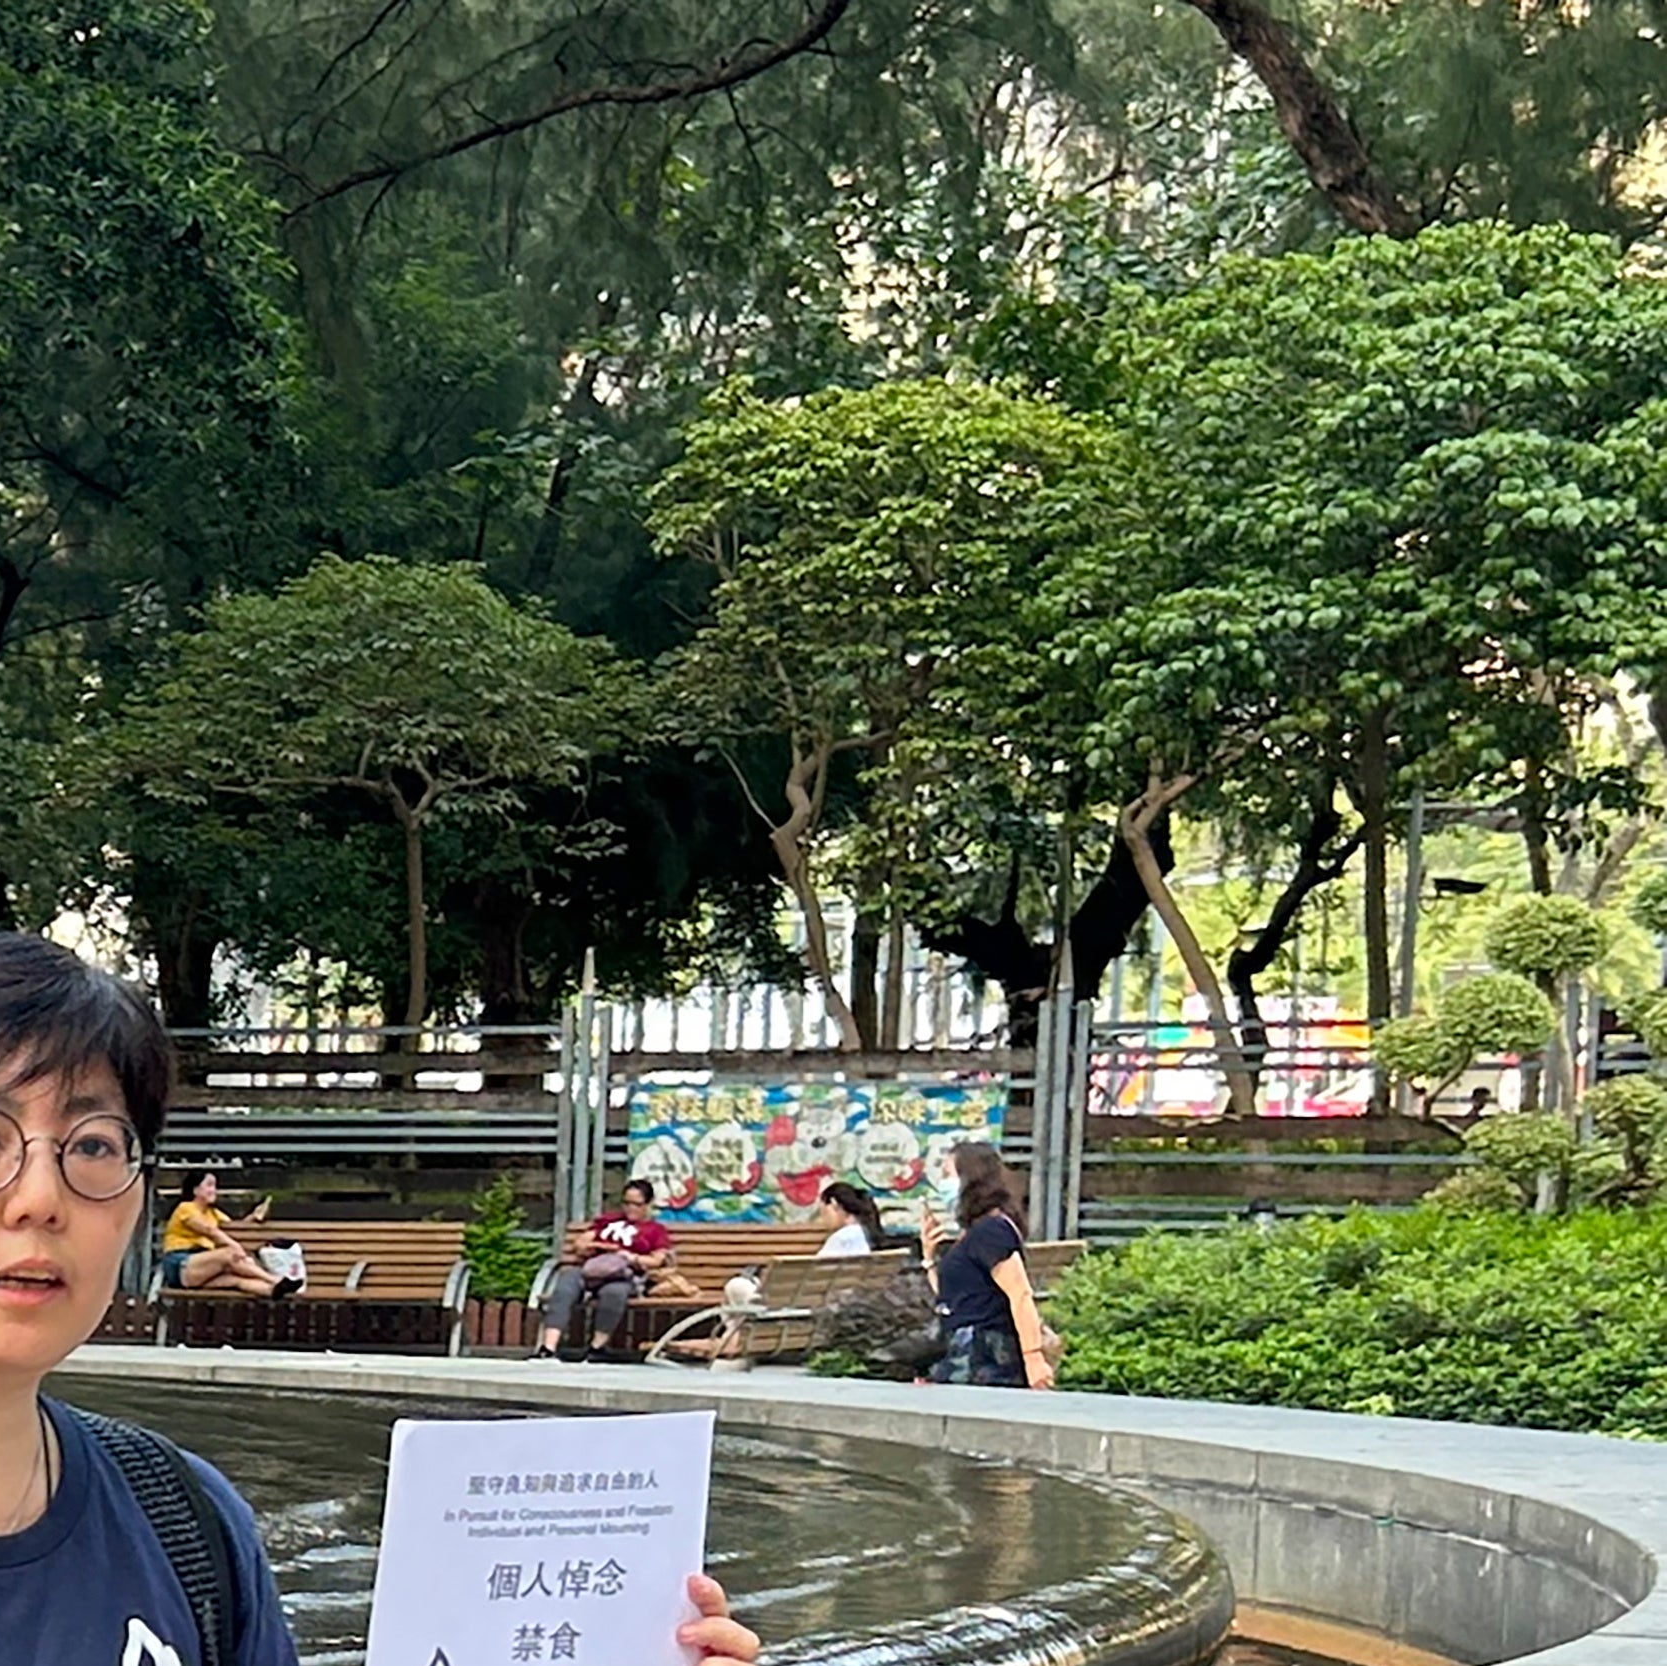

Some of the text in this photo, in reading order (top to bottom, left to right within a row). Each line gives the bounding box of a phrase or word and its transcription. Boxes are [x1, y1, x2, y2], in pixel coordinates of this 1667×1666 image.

[488, 1558, 626, 1600] 個人悼念
[512, 1621, 582, 1662] 禁食
